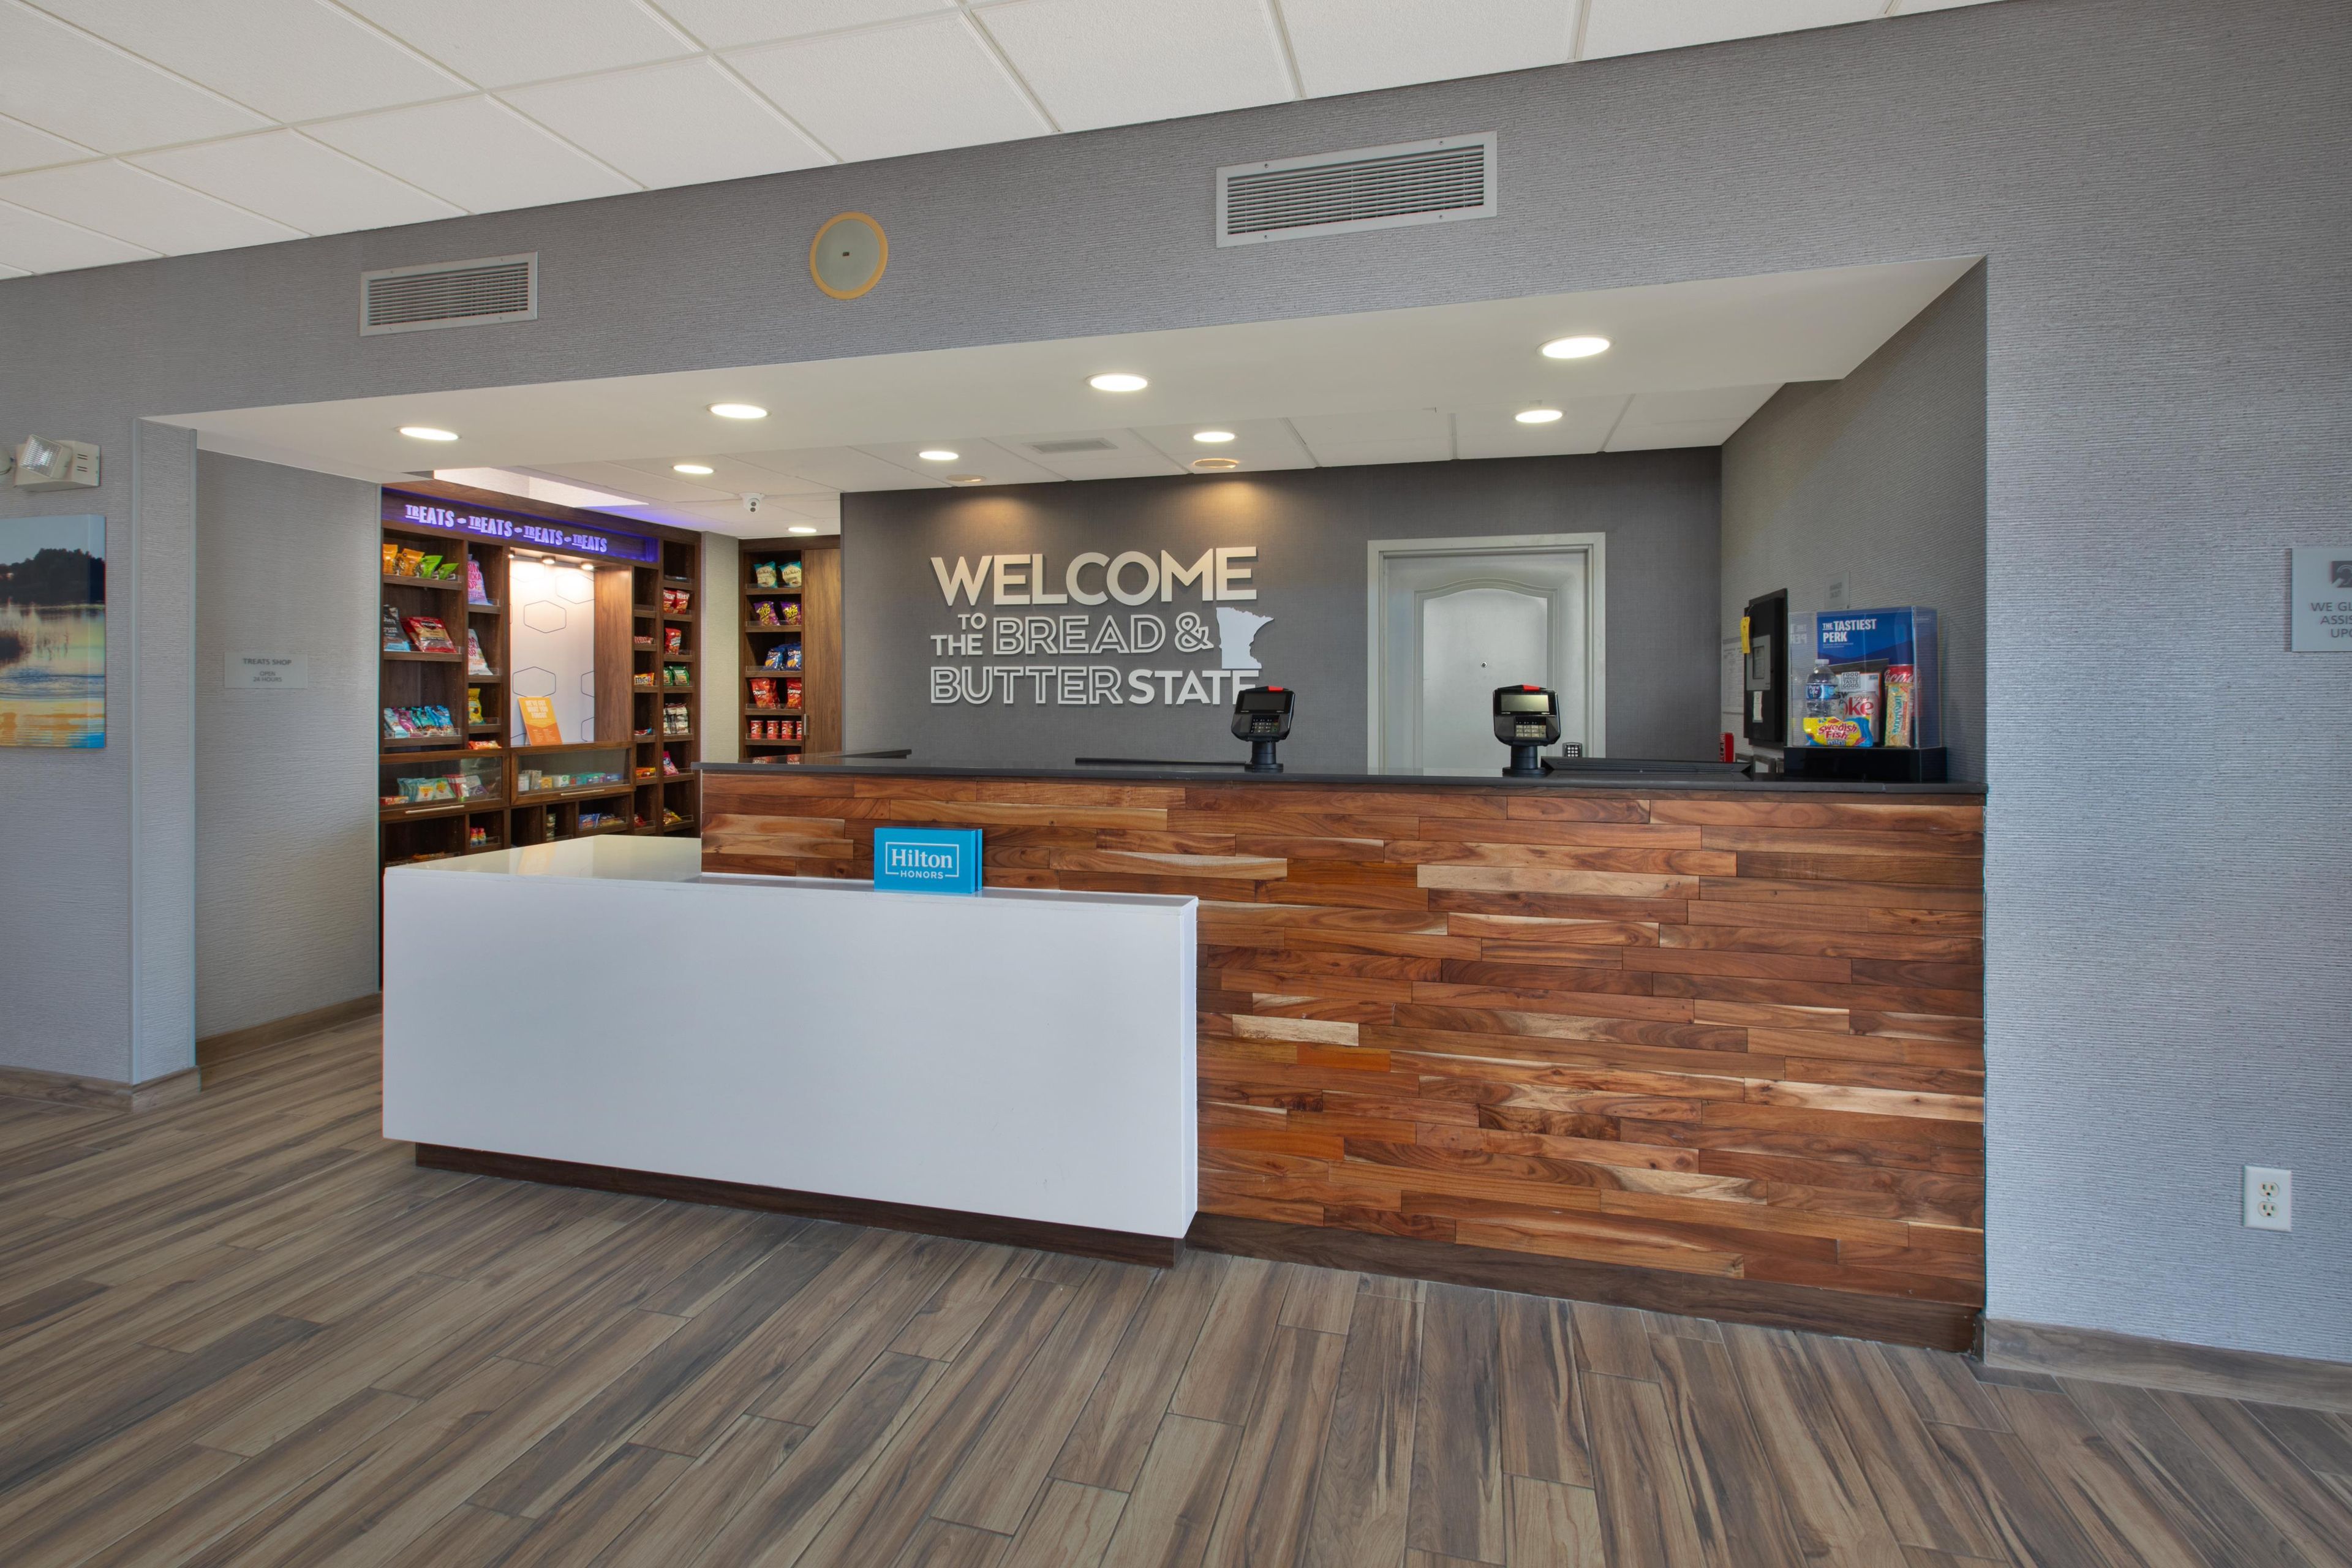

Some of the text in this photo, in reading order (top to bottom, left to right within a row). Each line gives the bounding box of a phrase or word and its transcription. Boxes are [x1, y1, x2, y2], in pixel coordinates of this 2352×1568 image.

[405, 505, 608, 552] TREATS TREATS TREATS TREATS
[930, 546, 1257, 606] WELCOME
[2311, 602, 2333, 612] WE
[957, 613, 987, 630] TO
[1833, 619, 1877, 631] TASTIEST
[993, 612, 1214, 655] BREAD &
[1823, 631, 1847, 643] PERK
[930, 634, 983, 655] THE
[930, 666, 1123, 704] BUTTER
[1819, 723, 1858, 734] Swedish
[1825, 731, 1849, 739] Fish
[891, 848, 953, 869] Hilton
[900, 870, 944, 879] HONORS
